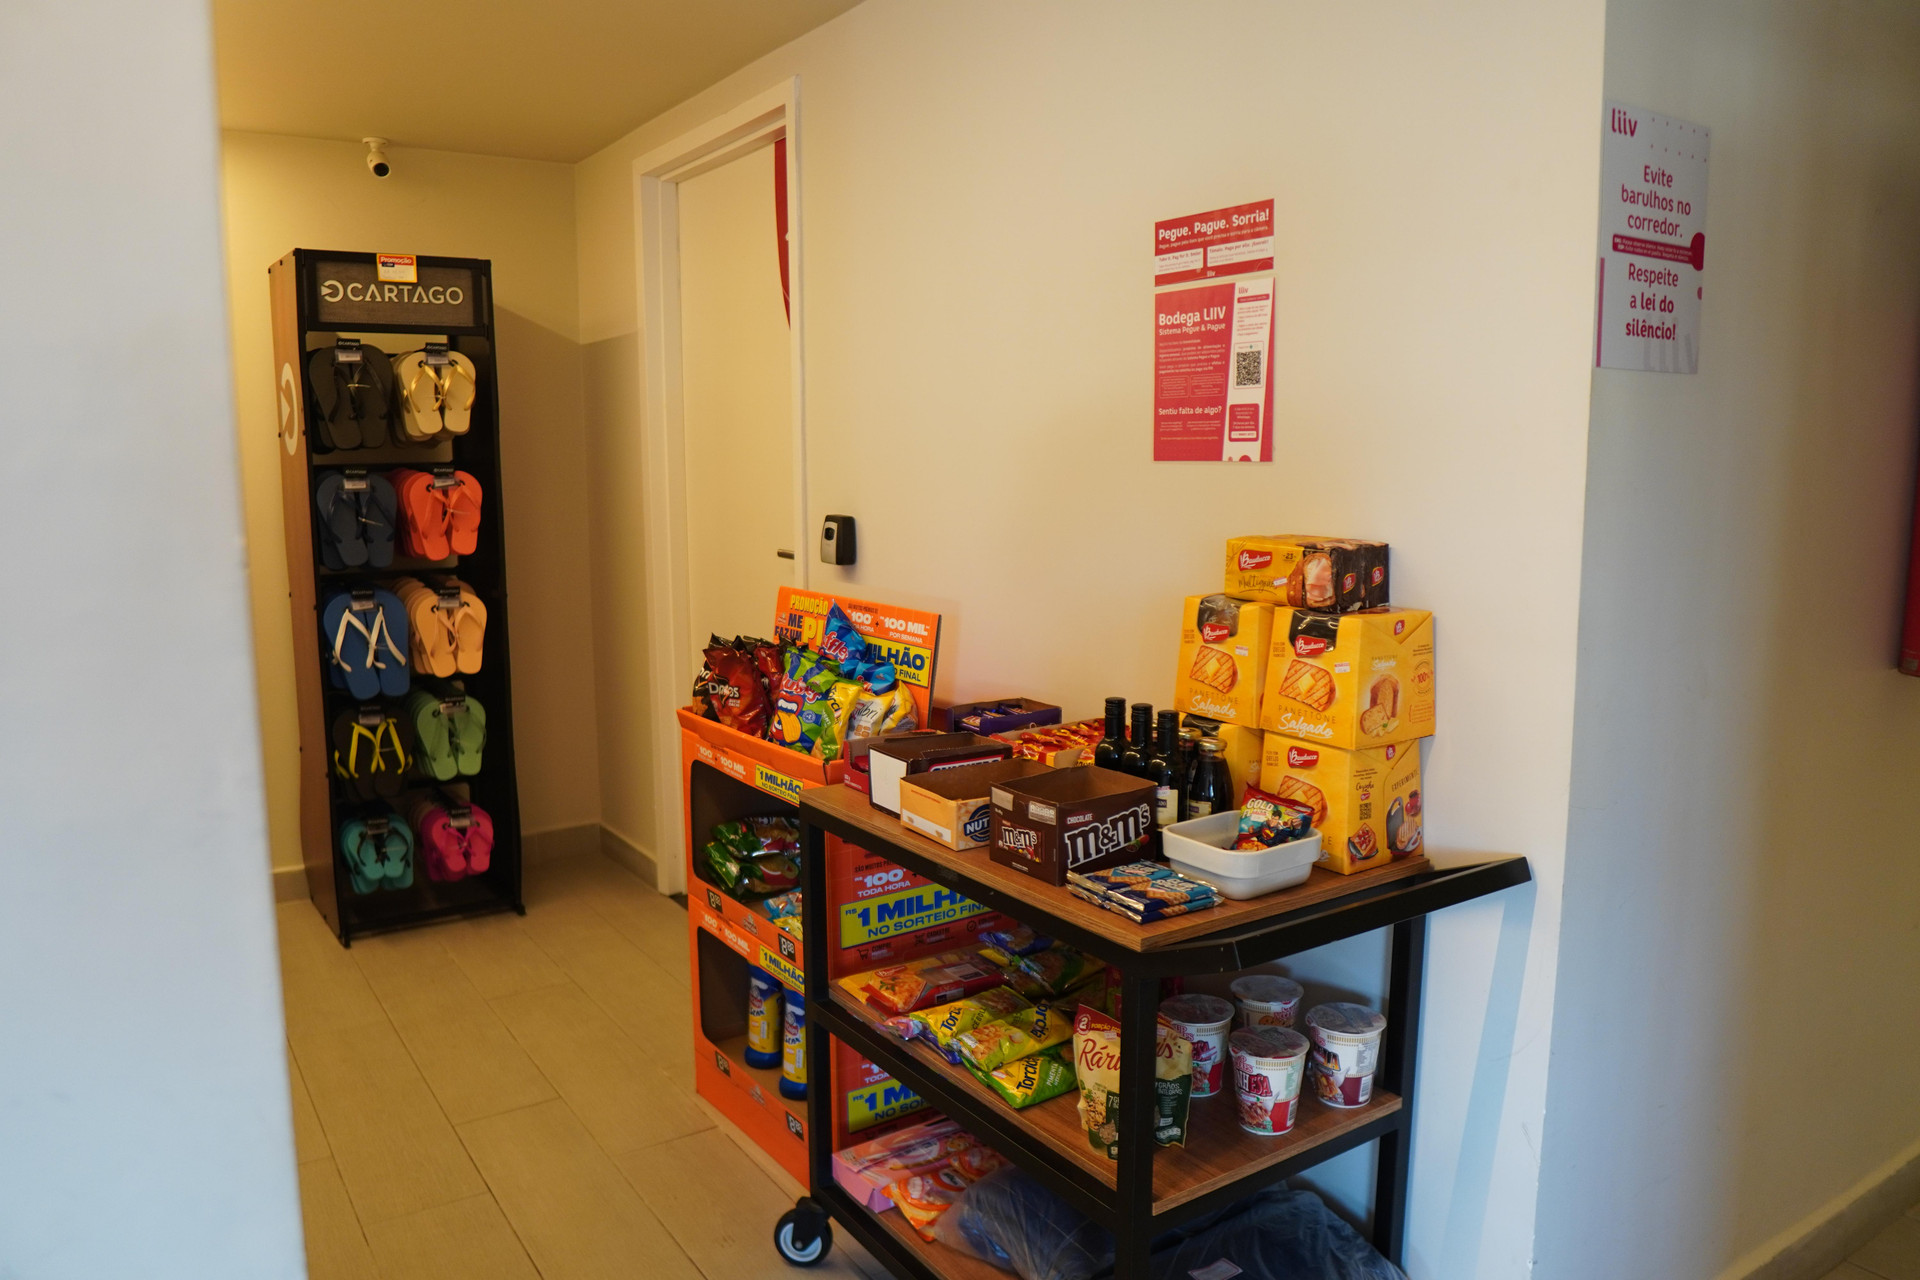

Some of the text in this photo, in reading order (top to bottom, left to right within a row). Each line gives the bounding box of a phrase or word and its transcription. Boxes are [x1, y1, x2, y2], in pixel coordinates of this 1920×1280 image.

[1611, 108, 1638, 137] liiv
[1644, 165, 1673, 188] Evite
[1621, 183, 1691, 216] barulhos no
[1158, 208, 1269, 242] Pegue. Pague. Sorria!
[1627, 214, 1683, 238] corredor.
[1628, 262, 1679, 288] Respeite
[347, 282, 464, 305] CARTAGO
[1630, 292, 1674, 313] a lei do
[1158, 311, 1201, 326] Bodega
[1203, 306, 1226, 321] LIIV
[1158, 327, 1181, 336] Sistema
[1182, 325, 1199, 335] Pegue
[1207, 322, 1226, 333] Pague
[1625, 318, 1676, 341] silêncio!
[1158, 405, 1222, 416] Sentiu falta de algo?
[790, 594, 828, 618] PROMOÇÃO
[787, 612, 804, 629] ME
[884, 617, 906, 631] 100
[907, 621, 929, 636] MIL
[775, 625, 789, 639] FAZ
[789, 629, 802, 642] UM
[822, 631, 849, 664] ffles
[900, 668, 921, 681] FINAL
[1190, 695, 1237, 719] Salgado
[1278, 704, 1337, 725] PANETTONE
[1278, 713, 1334, 739] Salgado
[760, 771, 763, 780] 1
[764, 773, 801, 796] MILHÃO
[1246, 798, 1275, 811] GOLD
[966, 817, 989, 835] NUT
[1066, 813, 1094, 824] CHOCOLATE
[857, 880, 911, 898] TODA HORA
[857, 907, 870, 927] 1
[877, 890, 968, 924] MILH
[867, 903, 990, 938] NO SORTEIO FINA
[769, 955, 804, 985] MILHÃO
[1079, 1017, 1087, 1029] 2
[1237, 1070, 1273, 1097] NHESA
[864, 1091, 877, 1112] 1
[874, 1107, 897, 1121] NO
